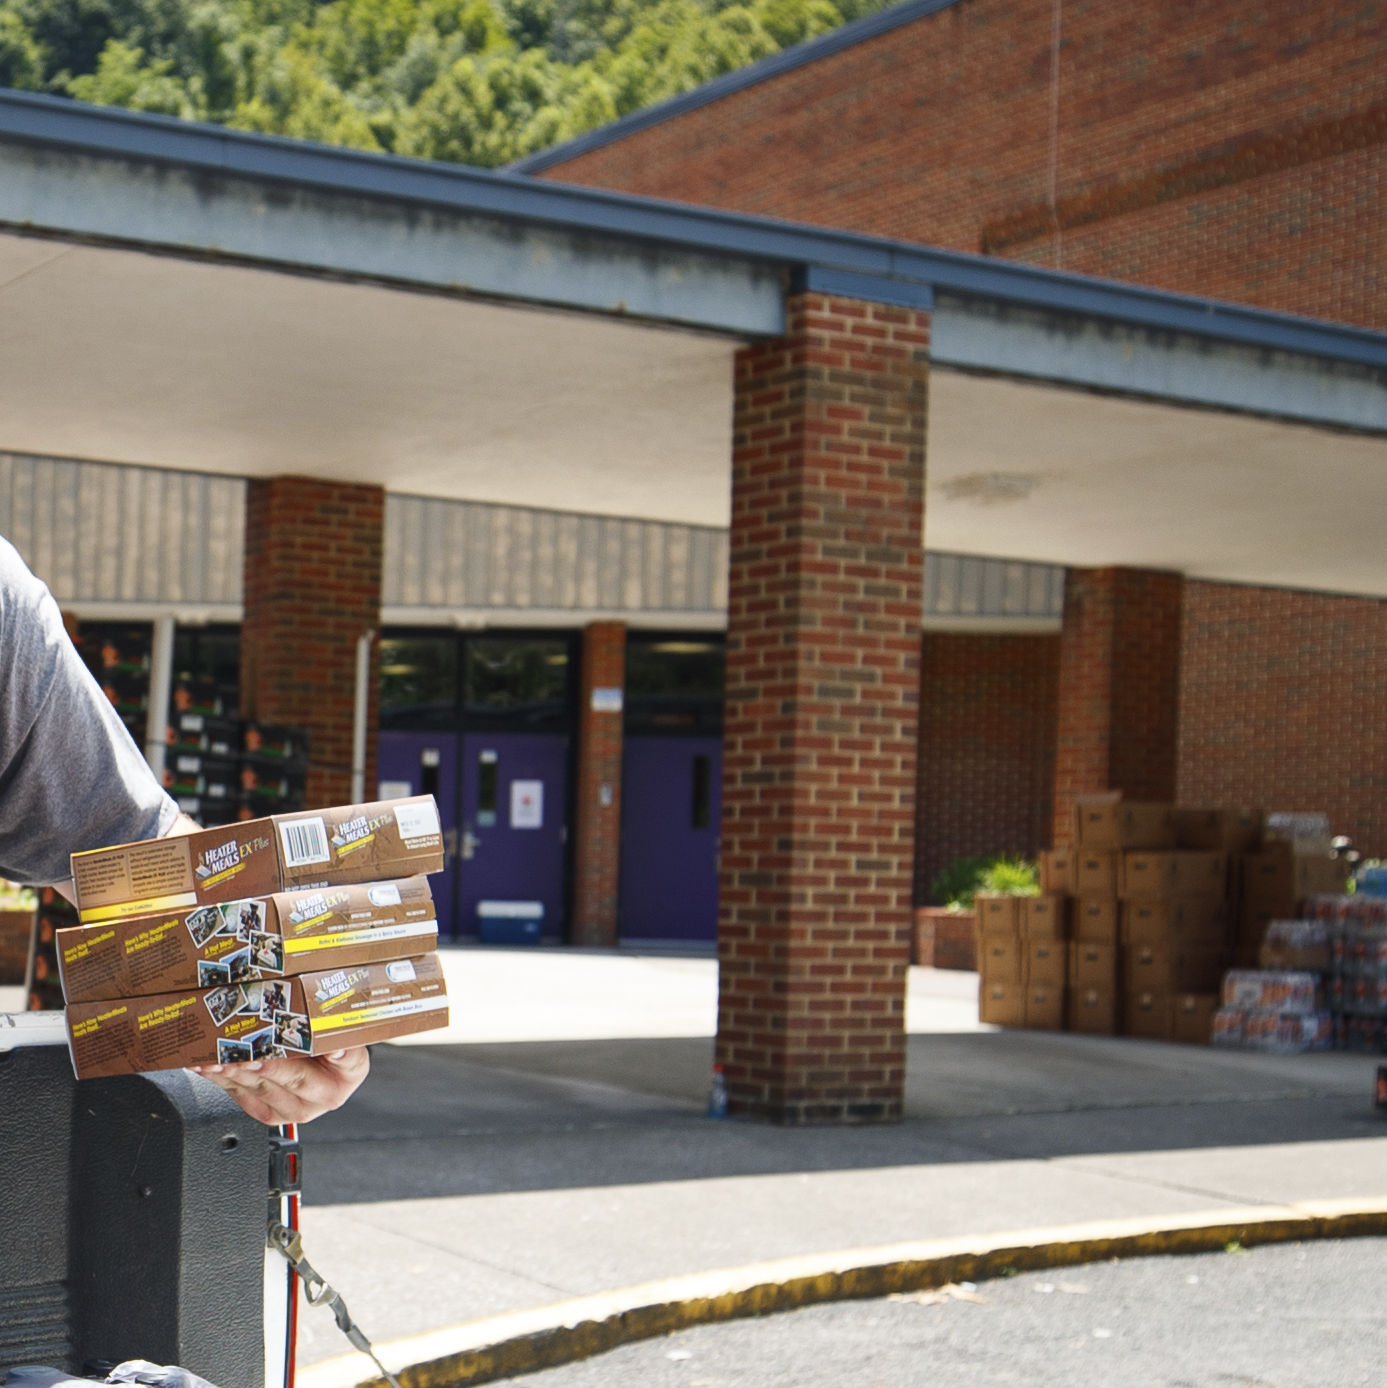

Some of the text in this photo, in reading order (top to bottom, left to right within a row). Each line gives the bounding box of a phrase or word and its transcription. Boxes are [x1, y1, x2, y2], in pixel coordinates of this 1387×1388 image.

[339, 815, 367, 836] HEATER
[368, 817, 381, 831] EX
[346, 826, 370, 844] MEALS
[205, 840, 237, 865] HEATER
[239, 842, 253, 859] EX
[211, 852, 239, 875] MEALS
[296, 893, 325, 912] HEATER
[326, 895, 337, 908] EX
[303, 904, 328, 920] MEALS
[321, 970, 359, 990] HEATER EX
[328, 981, 351, 998] MEALS
